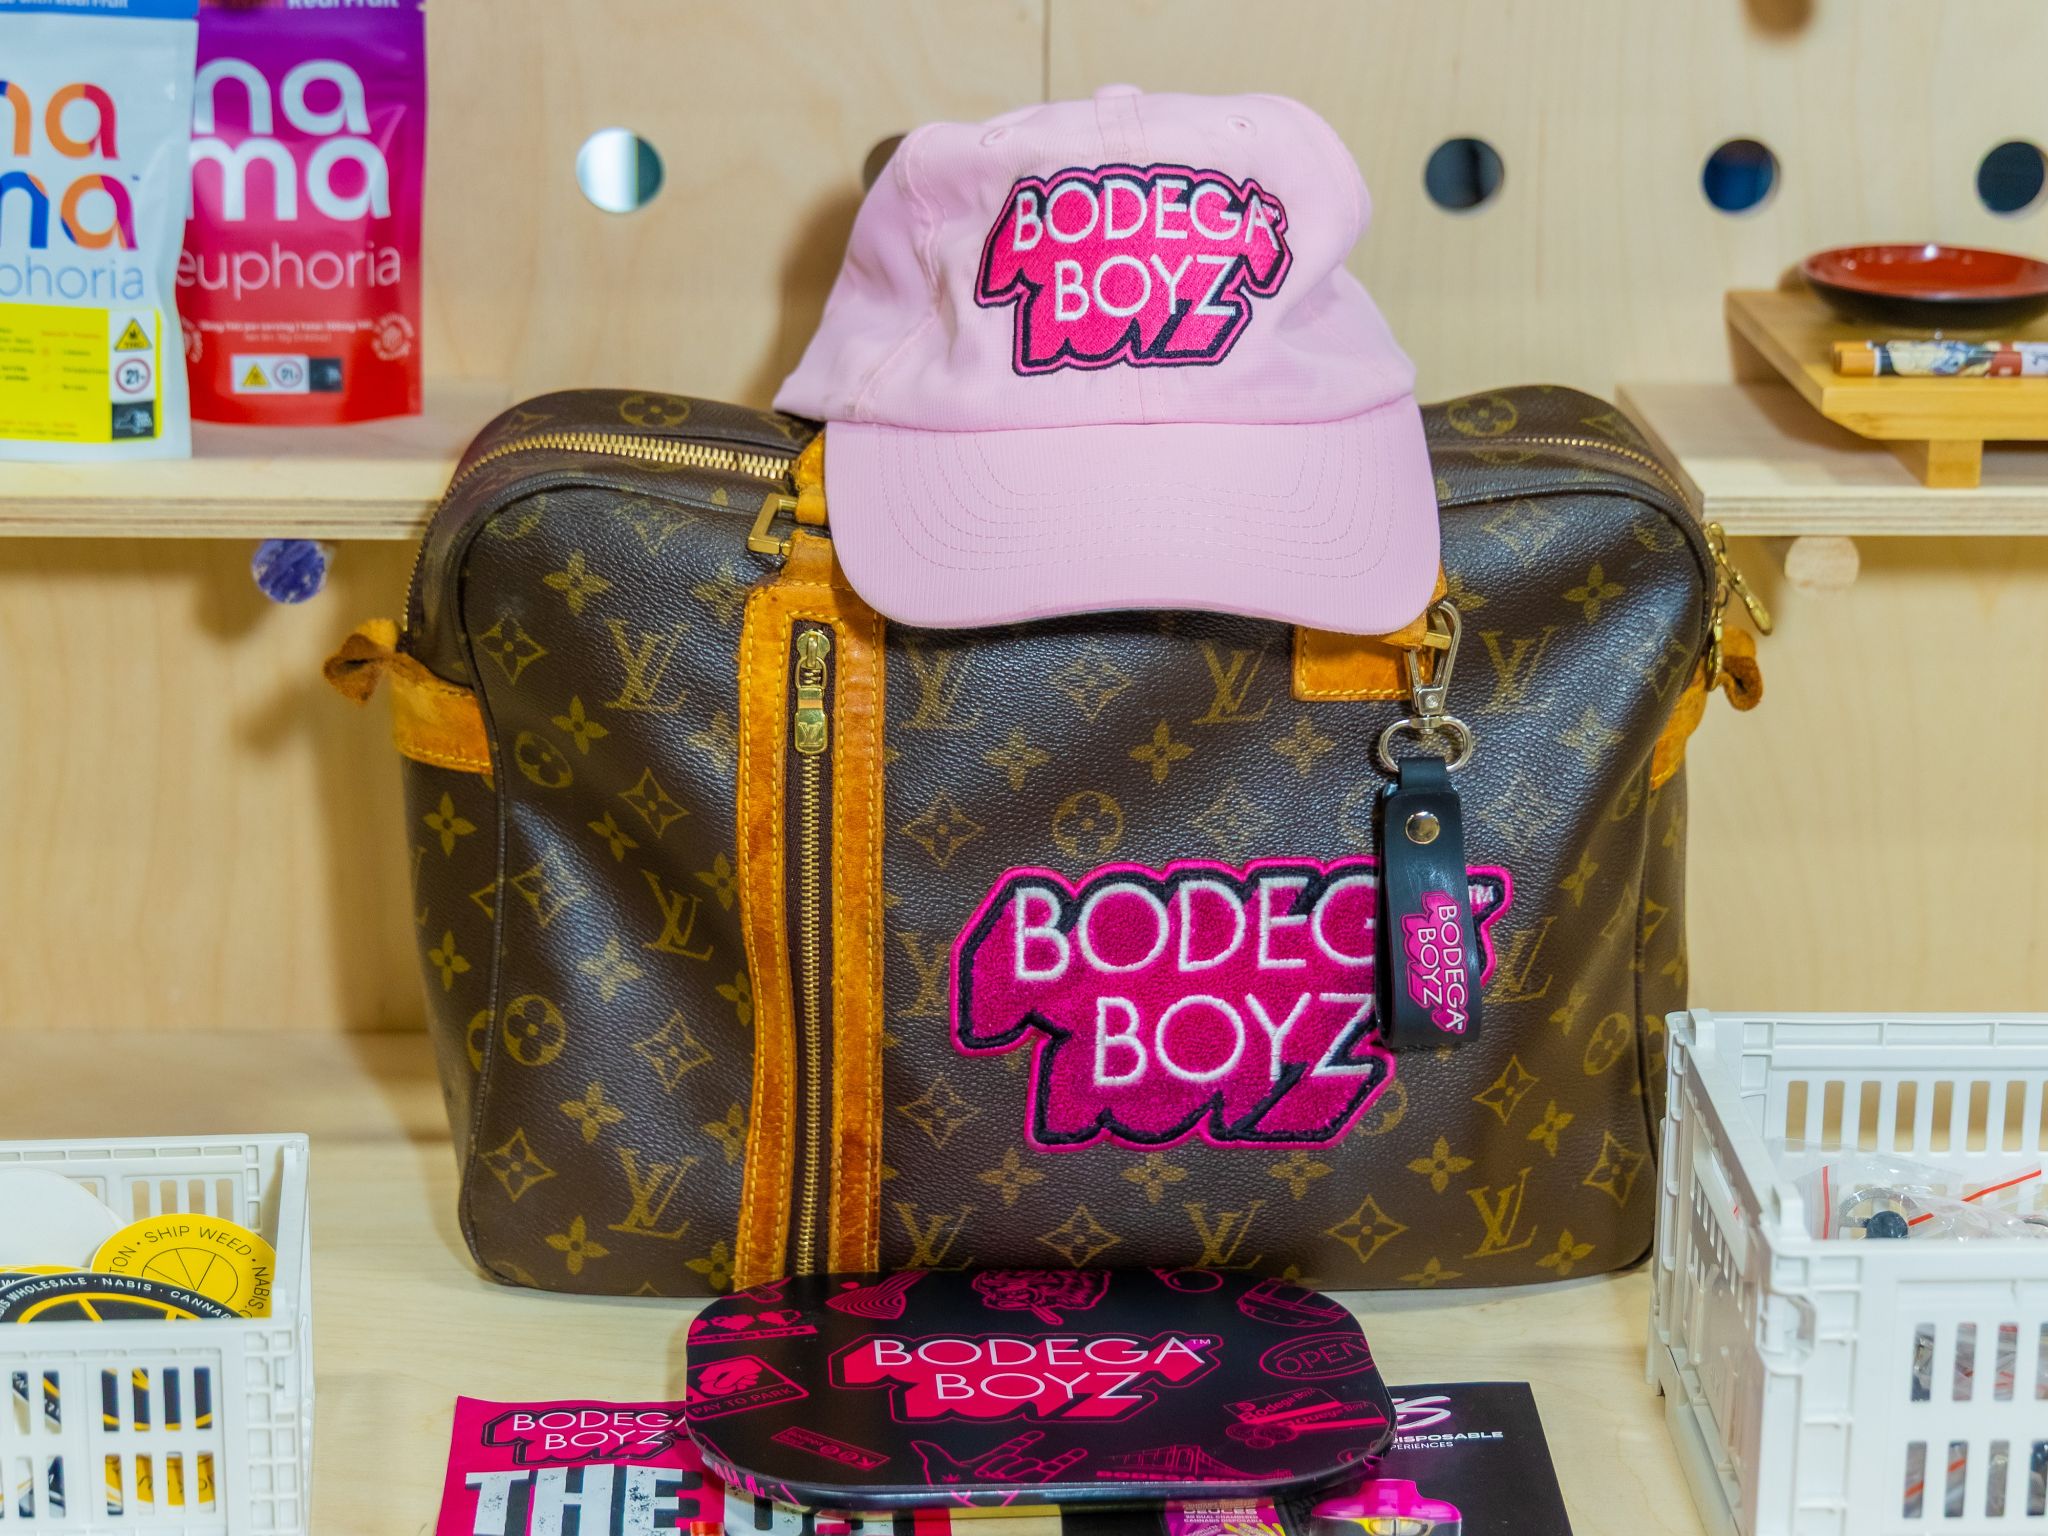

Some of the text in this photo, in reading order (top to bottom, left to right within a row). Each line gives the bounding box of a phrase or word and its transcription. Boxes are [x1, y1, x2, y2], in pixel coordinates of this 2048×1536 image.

[193, 57, 372, 135] na
[1012, 178, 1281, 252] BODEGA
[175, 240, 401, 300] euphoria
[1054, 254, 1239, 322] BOYZ
[1012, 874, 1379, 982] BODEG
[1417, 927, 1443, 1005] BOYZ
[1438, 905, 1467, 1028] BODEGA
[1093, 990, 1375, 1087] BOYZ
[6, 1277, 88, 1302] WHOLESALE
[102, 1277, 152, 1291] NABIS
[170, 1290, 232, 1319] CANNAB
[109, 1225, 270, 1311] TON SHIP WEED NABIS
[873, 1336, 1205, 1366] BODEGA
[935, 1371, 1143, 1400] BOYZ
[692, 1387, 794, 1415] PAY TO PARK
[544, 1429, 666, 1450] BOYZ
[466, 1464, 683, 1536] THE
